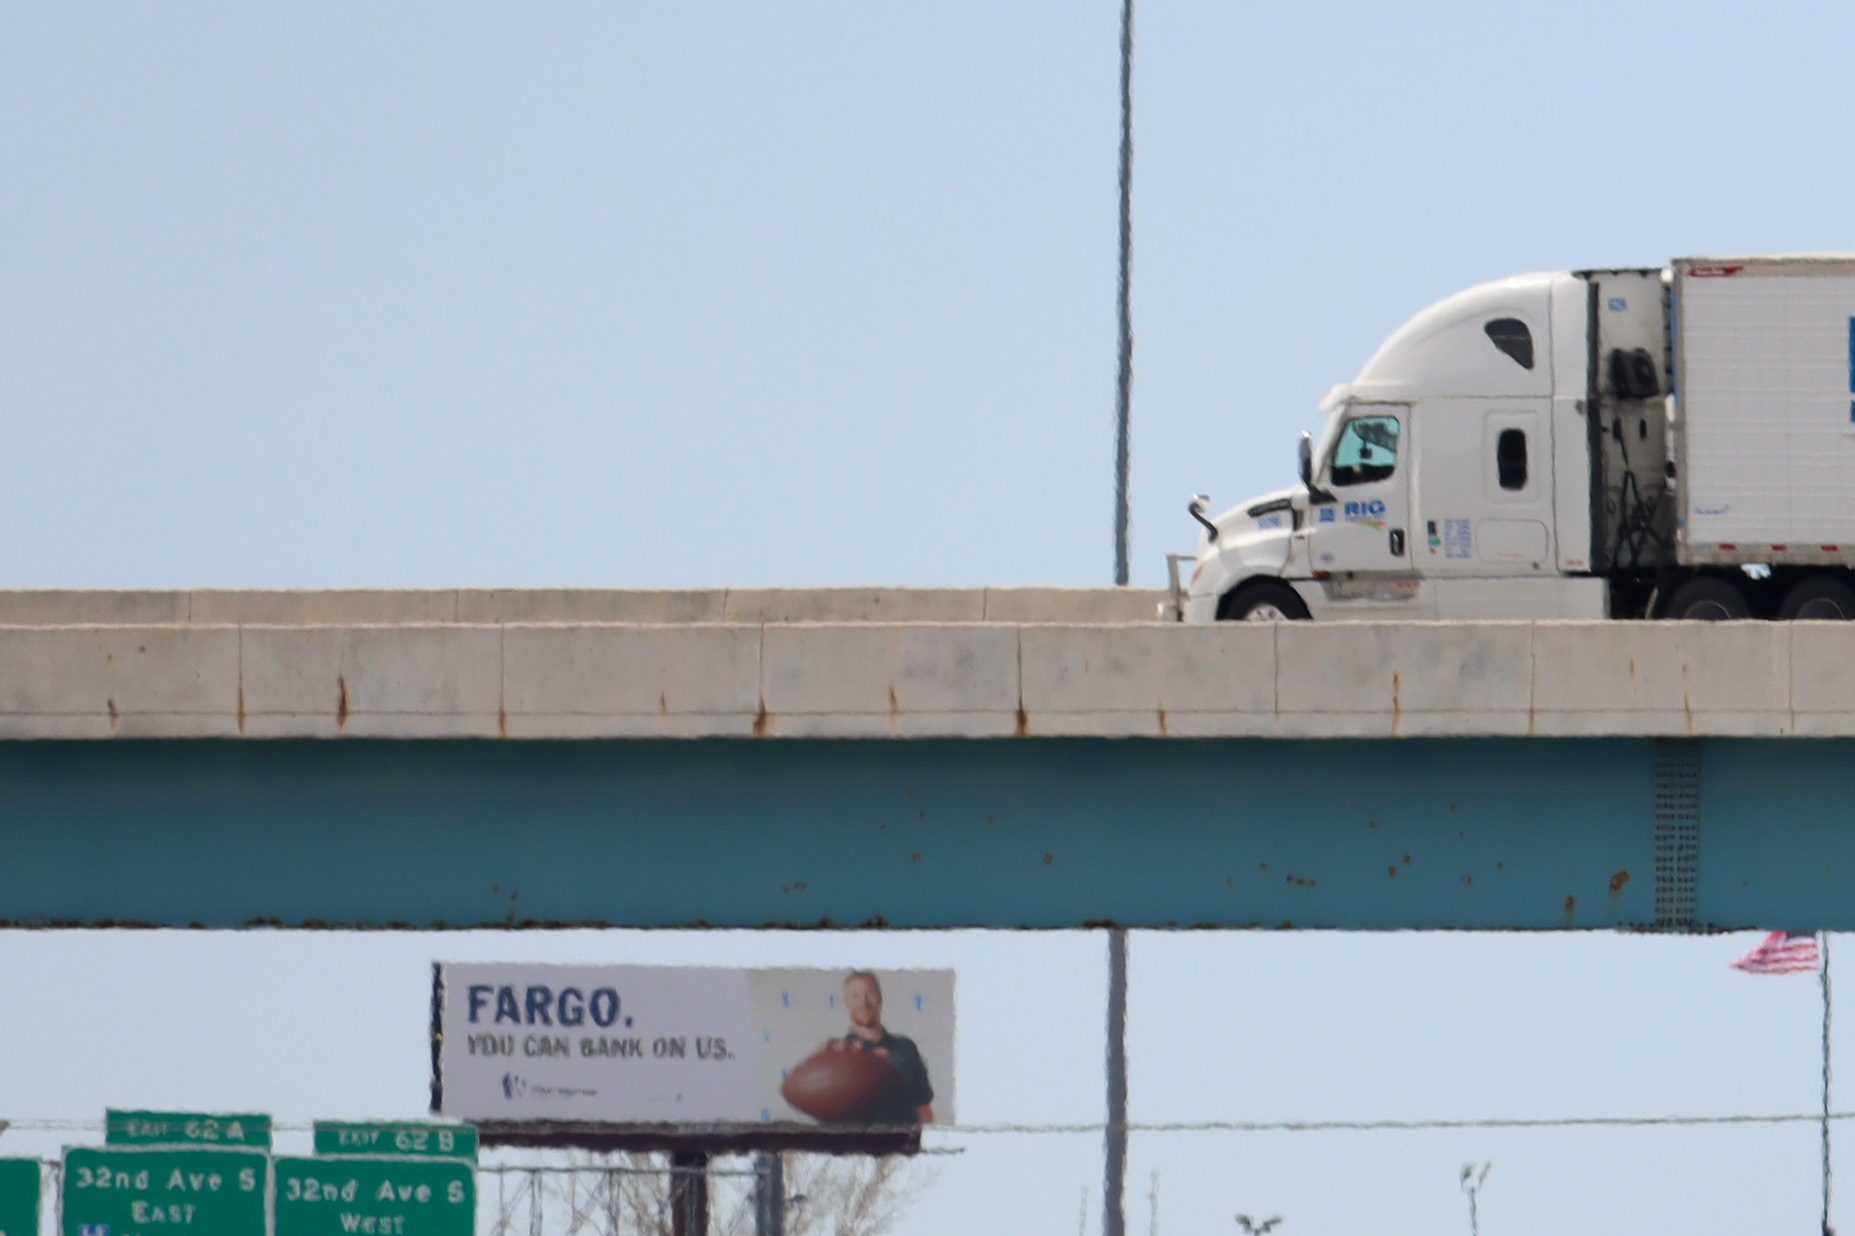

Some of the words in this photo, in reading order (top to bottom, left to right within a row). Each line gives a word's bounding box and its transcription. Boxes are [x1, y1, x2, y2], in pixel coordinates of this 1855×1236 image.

[467, 984, 633, 1028] FARGO.
[467, 1033, 515, 1058] YOU
[523, 1034, 571, 1058] CAN
[579, 1035, 645, 1059] BANK
[652, 1034, 686, 1059] ON
[76, 1166, 150, 1190] 32nd
[165, 1167, 223, 1192] Ave
[238, 1167, 256, 1192] S
[286, 1177, 359, 1202] 32nd
[375, 1179, 432, 1203] Ave
[447, 1180, 465, 1204] S
[131, 1200, 196, 1225] EAST
